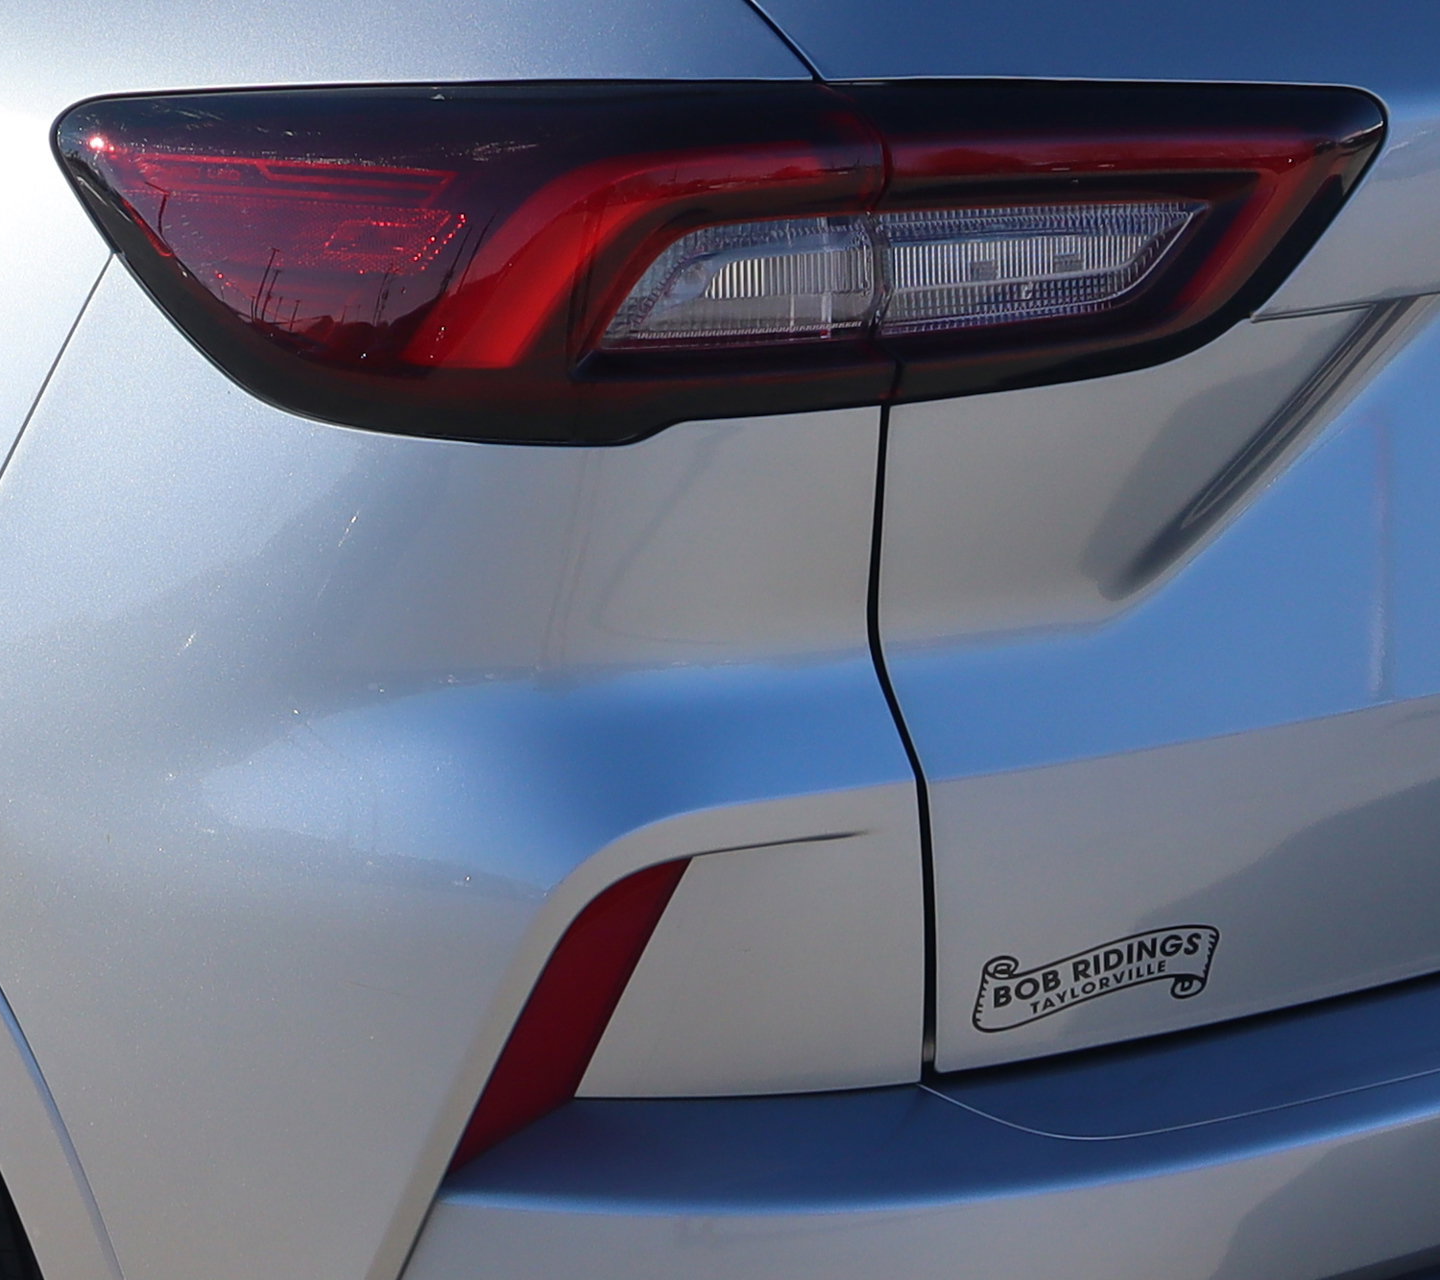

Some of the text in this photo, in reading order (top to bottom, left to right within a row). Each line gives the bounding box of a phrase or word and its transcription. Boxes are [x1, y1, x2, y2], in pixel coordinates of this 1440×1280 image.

[993, 933, 1202, 1008] BOB RIDINGS
[1030, 960, 1167, 1014] TAYLORVILLE
